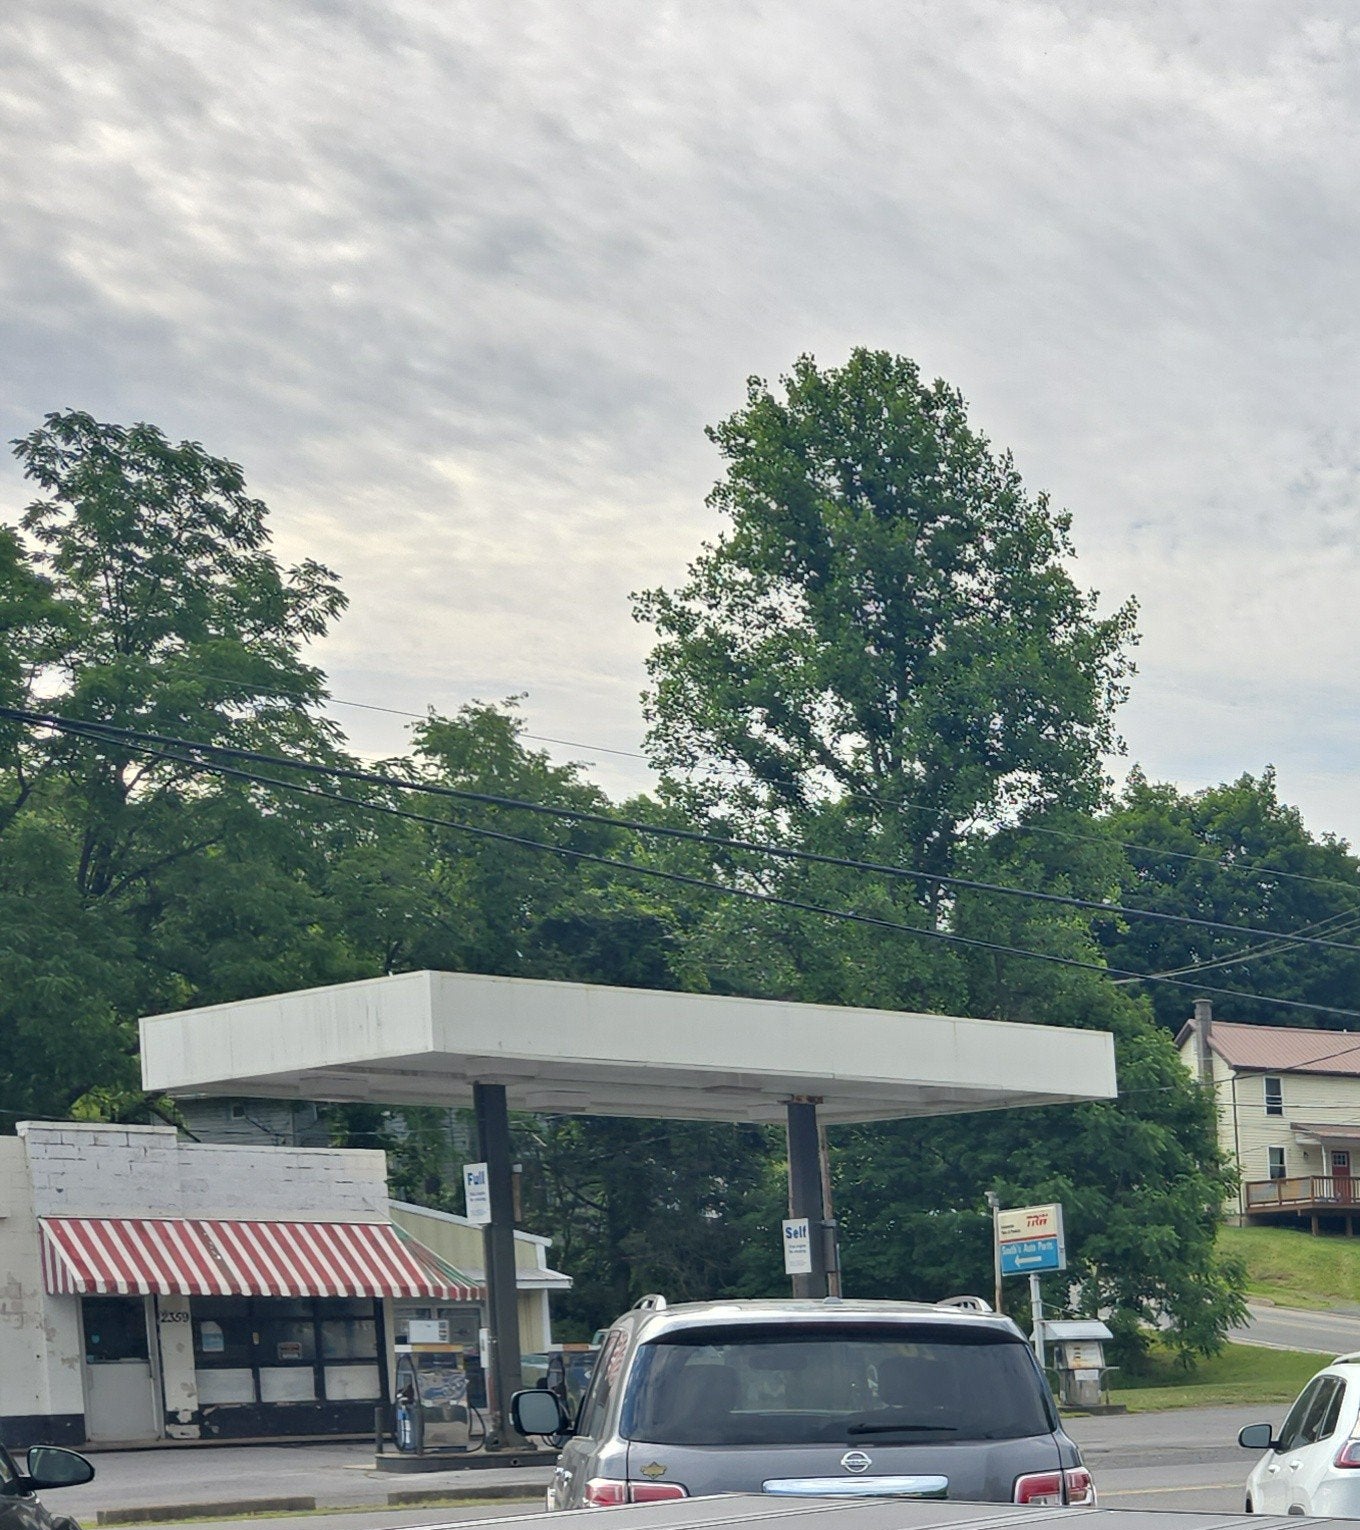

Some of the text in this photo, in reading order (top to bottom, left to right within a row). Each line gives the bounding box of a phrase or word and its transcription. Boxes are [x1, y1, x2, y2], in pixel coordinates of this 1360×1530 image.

[467, 1170, 485, 1185] Full
[785, 1225, 806, 1238] Self
[160, 1312, 189, 1322] 2359
